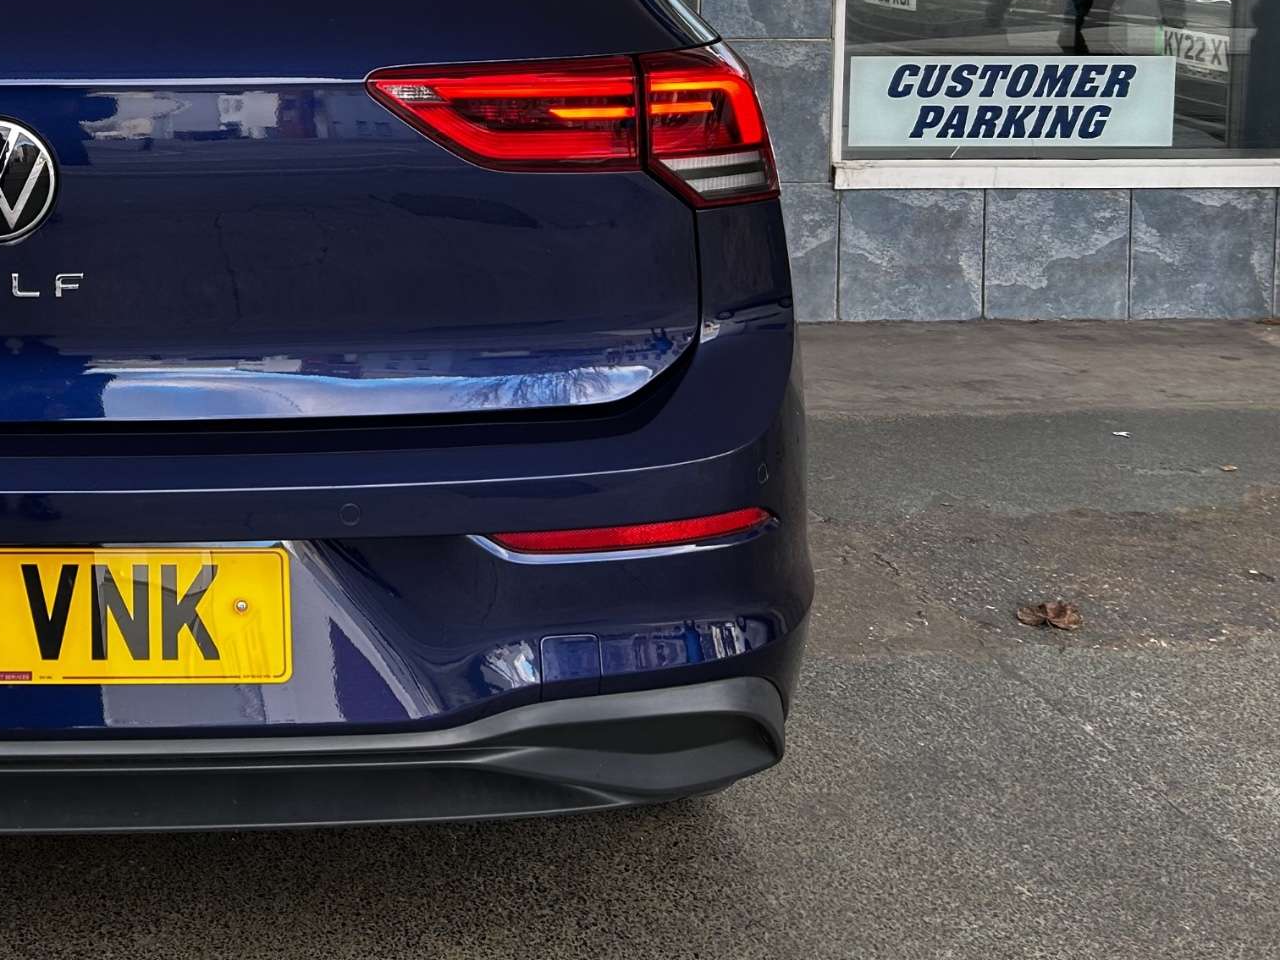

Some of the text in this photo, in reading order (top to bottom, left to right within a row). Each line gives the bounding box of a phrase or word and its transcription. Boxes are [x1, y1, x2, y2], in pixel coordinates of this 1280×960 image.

[1164, 29, 1206, 62] KY22
[887, 63, 1138, 98] CUSTOMER
[909, 105, 1113, 139] PARKING
[20, 563, 220, 661] VNK
